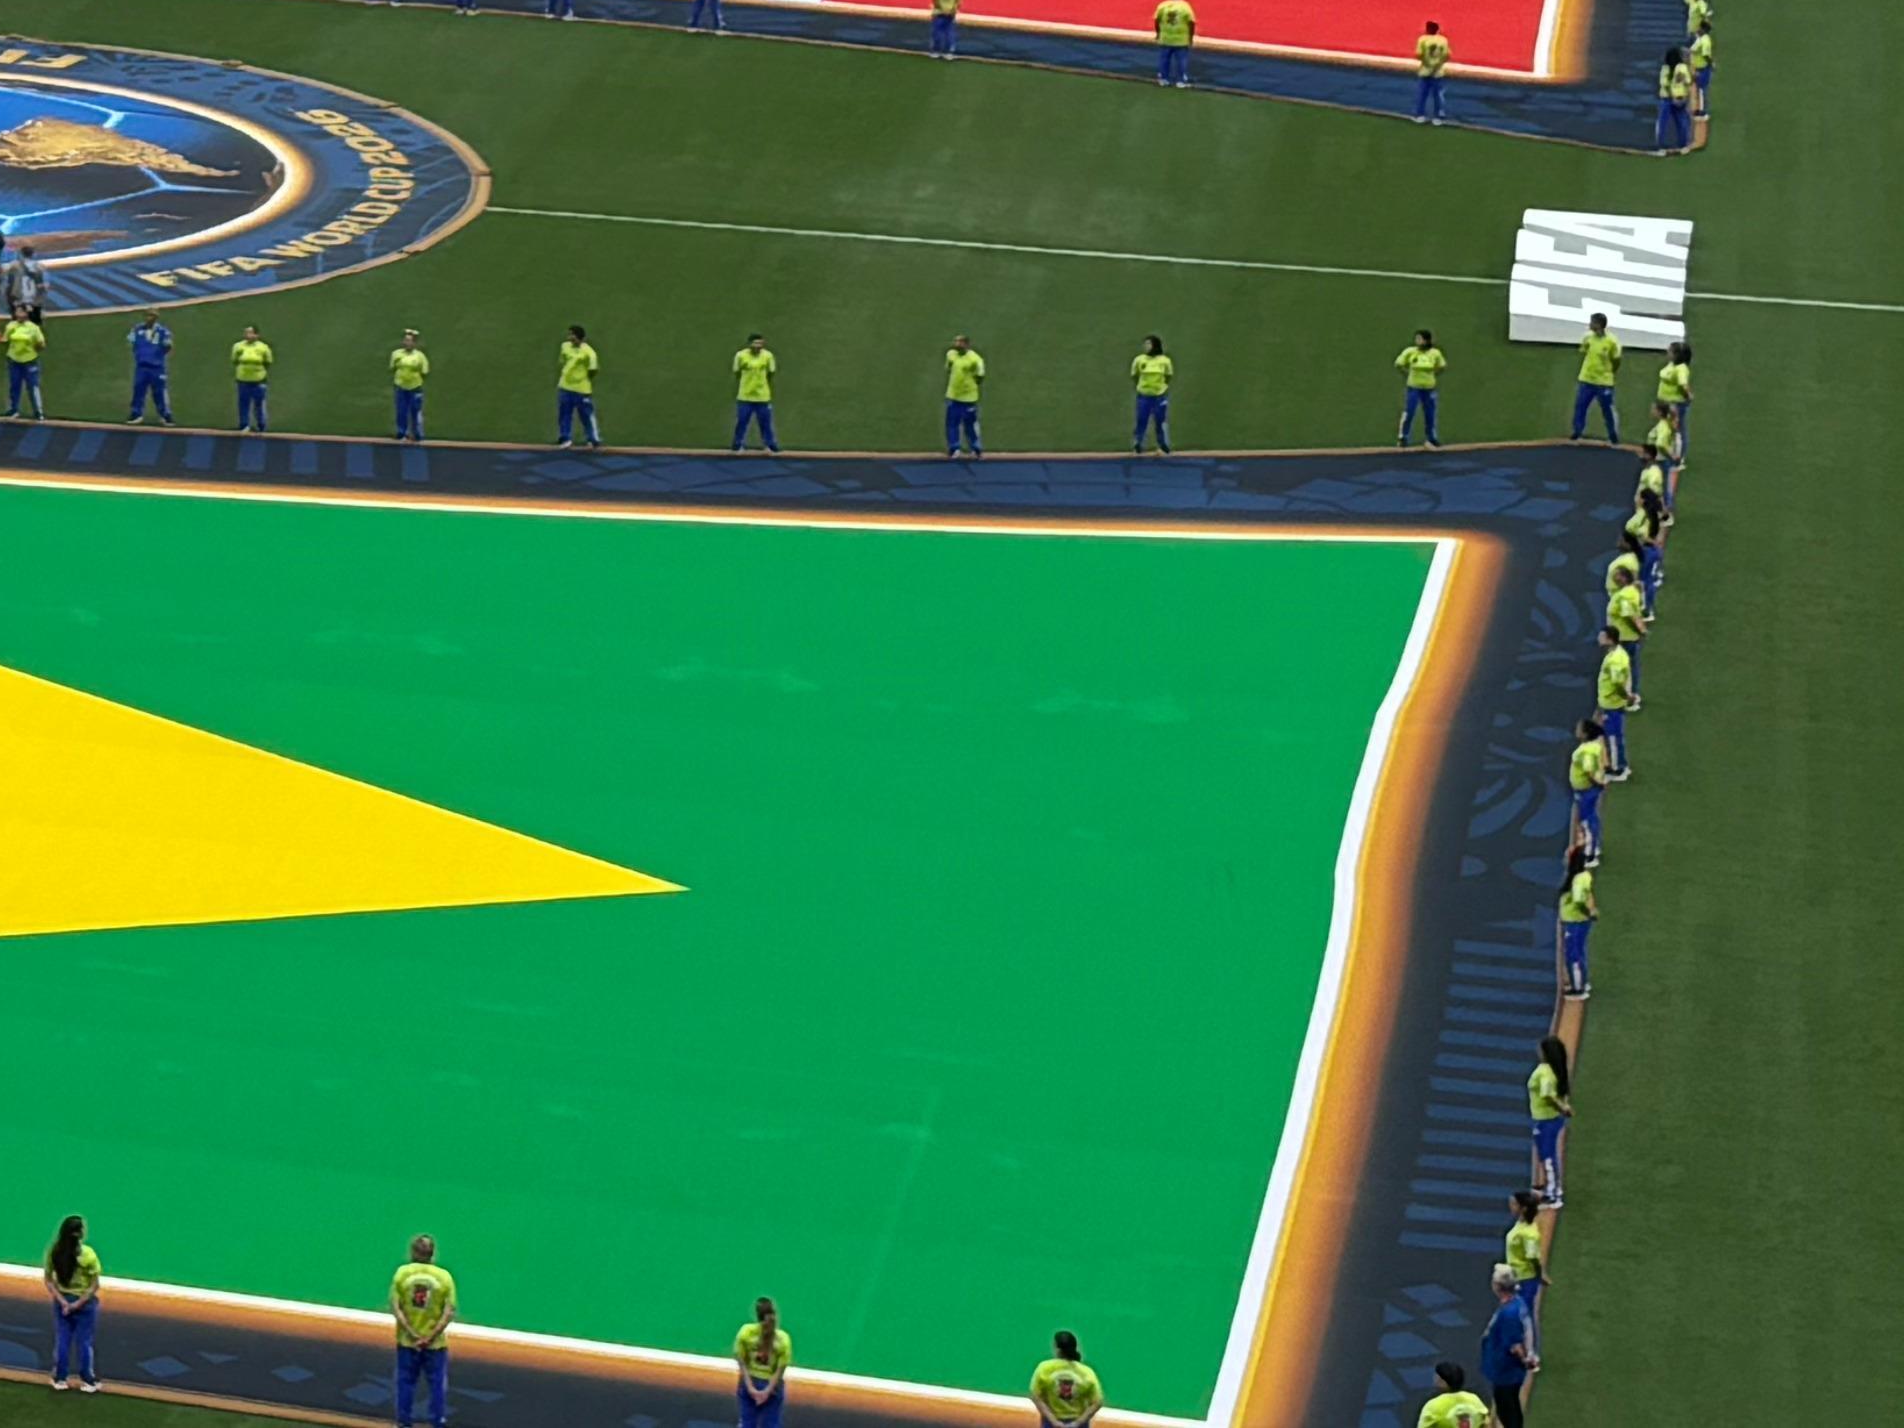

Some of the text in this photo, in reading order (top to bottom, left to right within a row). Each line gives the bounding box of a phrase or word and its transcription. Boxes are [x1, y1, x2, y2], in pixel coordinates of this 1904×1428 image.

[138, 108, 416, 288] FIFA WORLD CUP 2026
